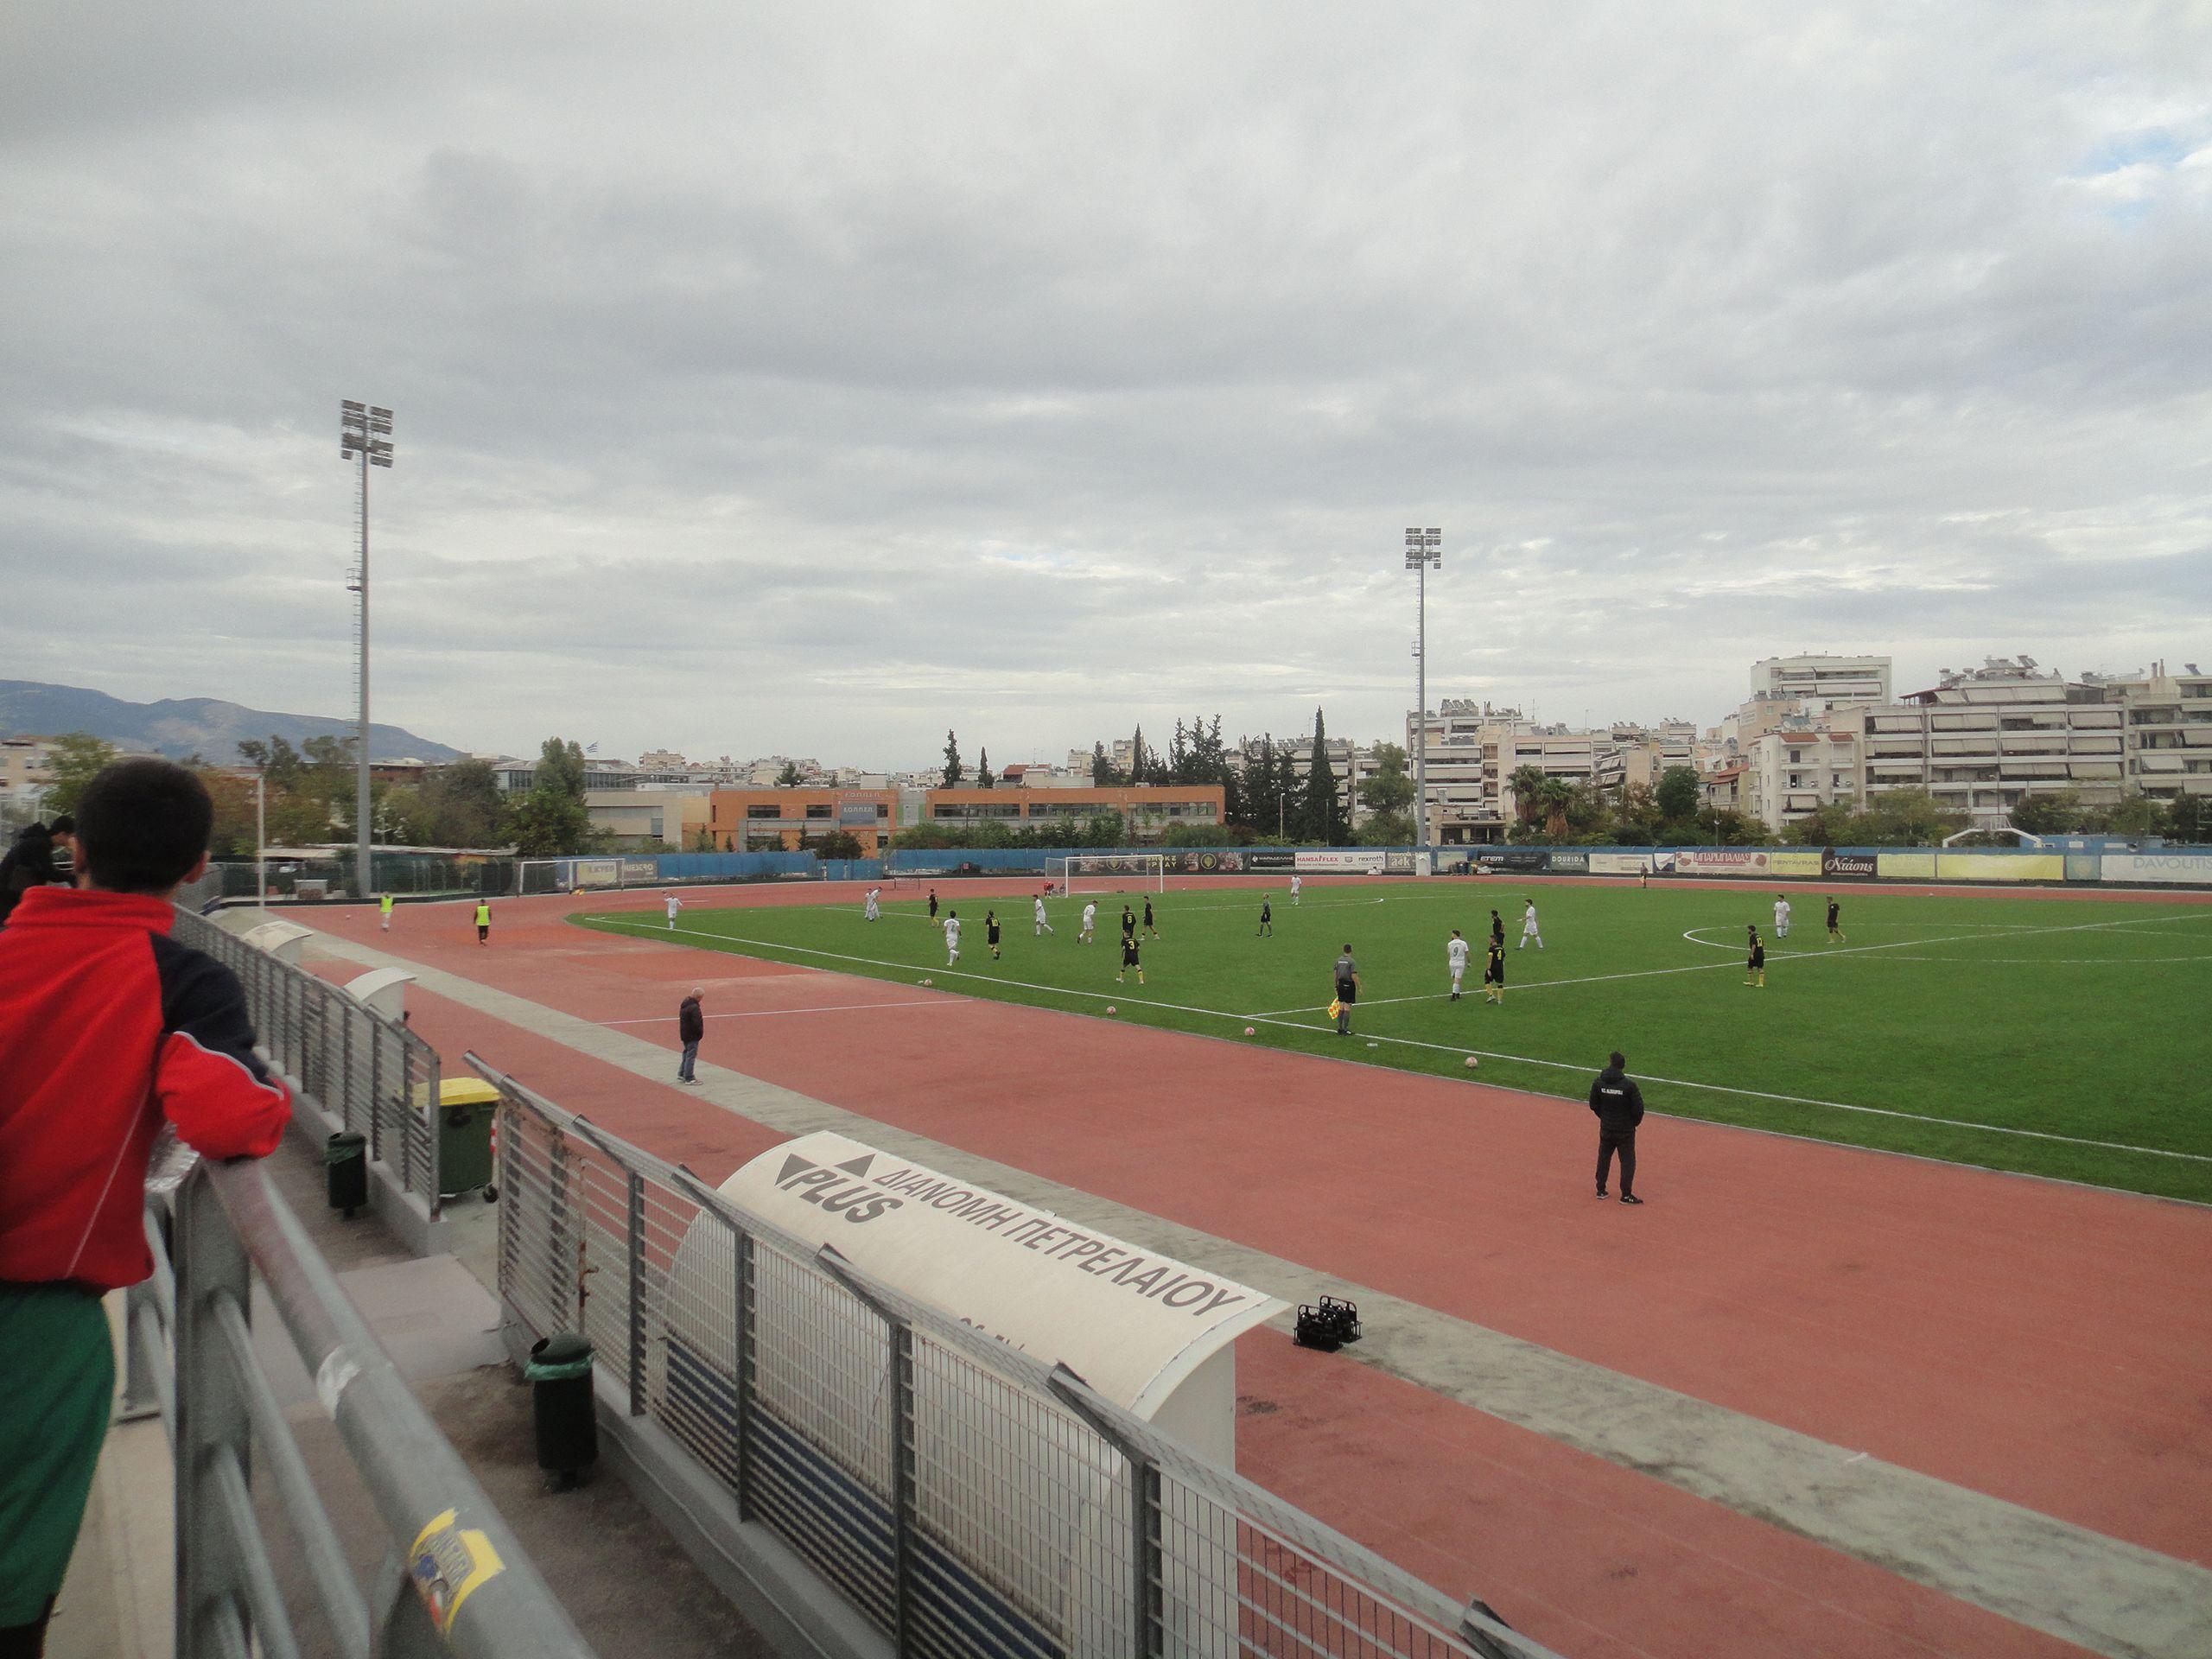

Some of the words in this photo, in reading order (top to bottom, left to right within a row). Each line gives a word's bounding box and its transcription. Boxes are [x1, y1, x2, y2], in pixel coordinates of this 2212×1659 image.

[991, 918, 999, 927] 10
[1128, 941, 1135, 950] 3
[1453, 947, 1459, 957] 9
[1497, 950, 1502, 960] 4
[780, 1168, 904, 1224] PLUS
[872, 1169, 1024, 1230] ΔΙΑΝΟΜΗ
[1001, 1218, 1246, 1317] ΠΕΤΡΕΛΑΙΟΥ
